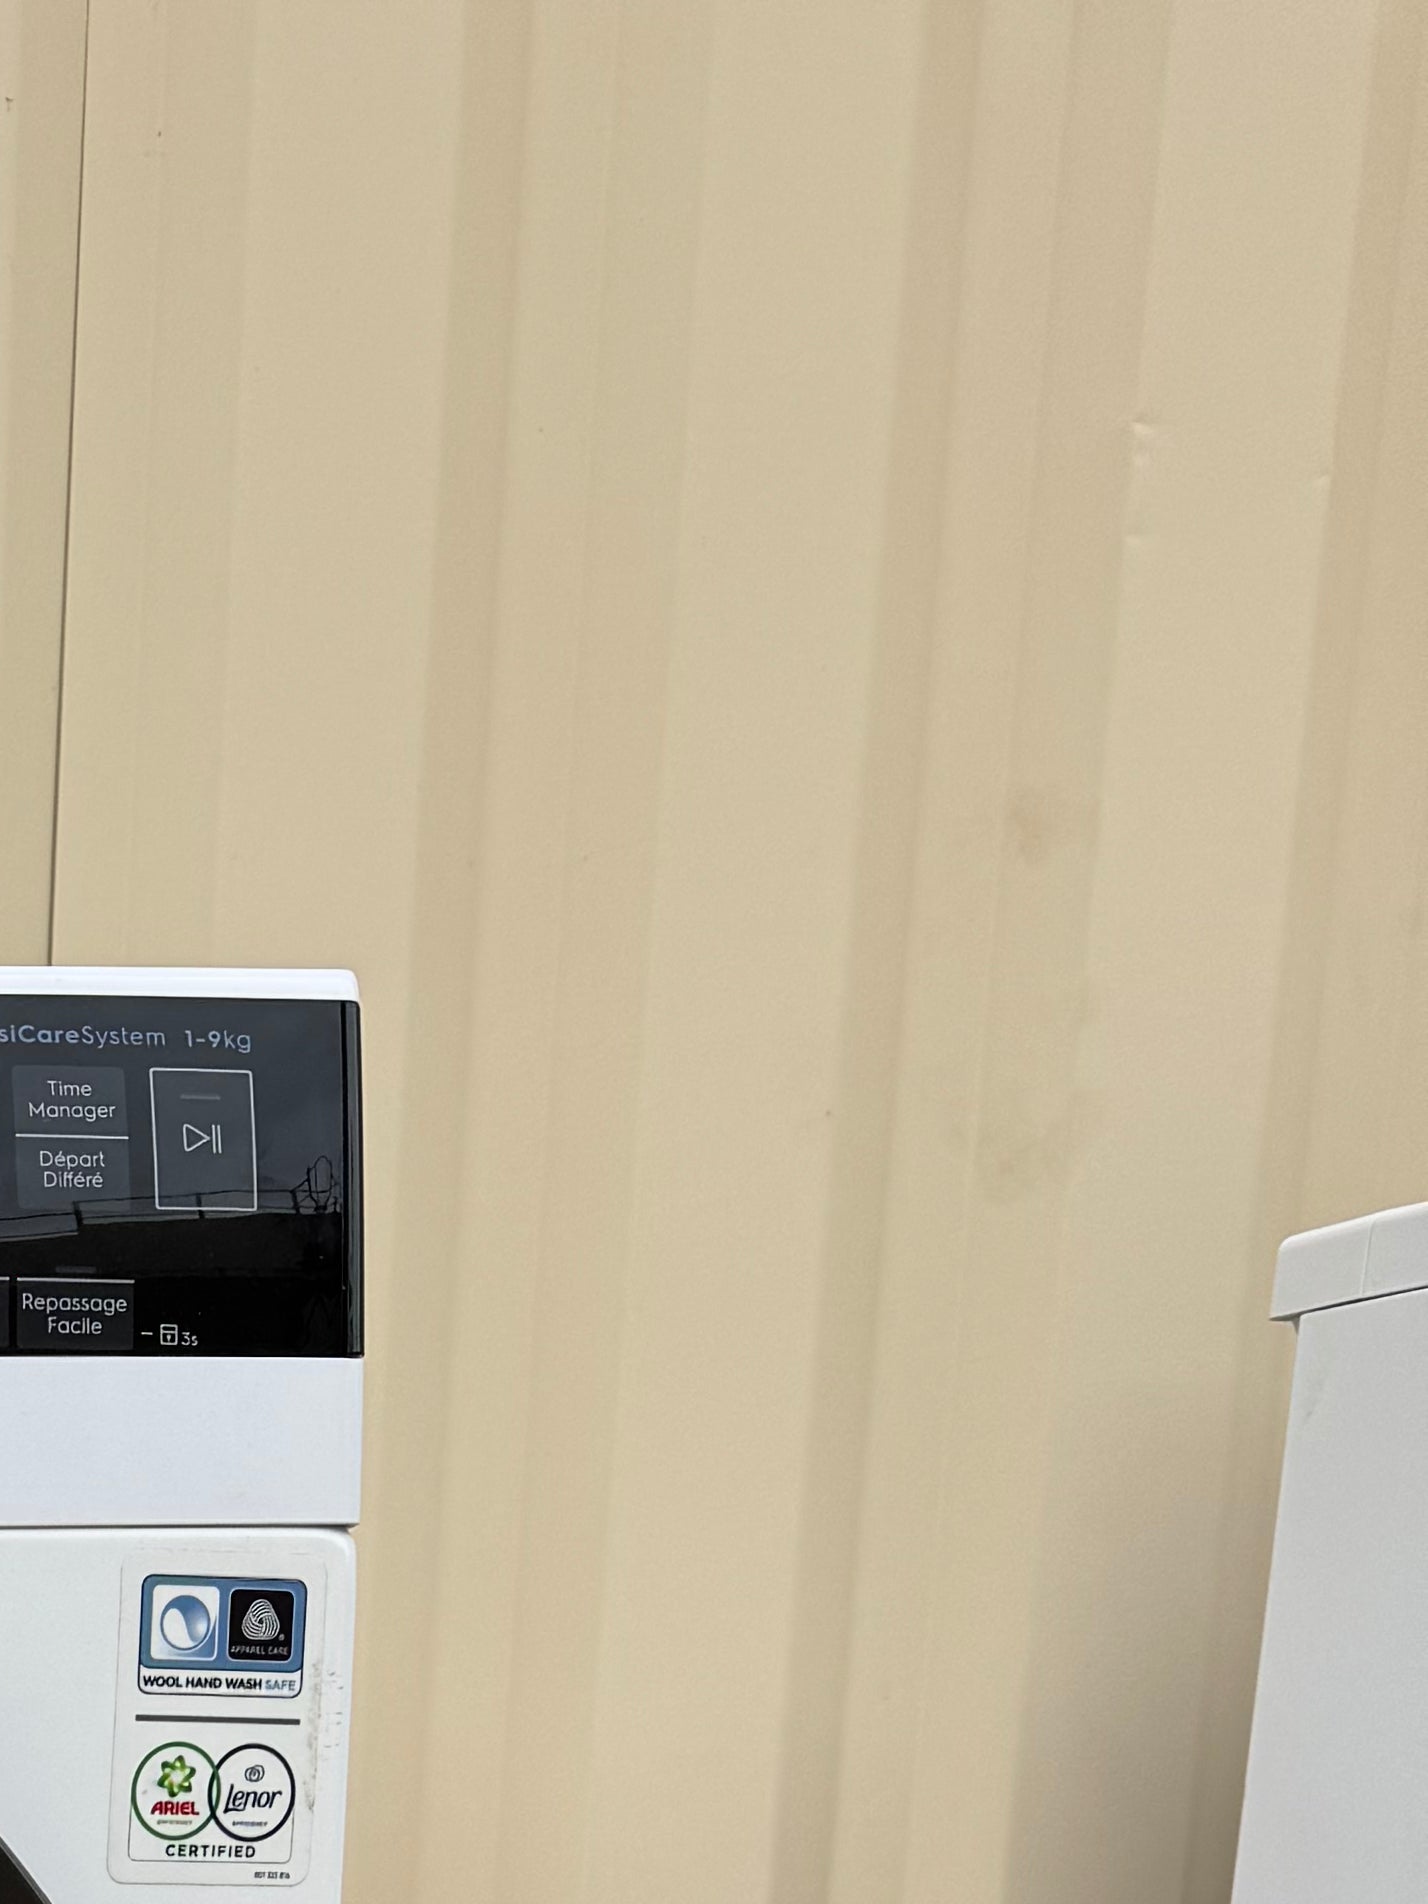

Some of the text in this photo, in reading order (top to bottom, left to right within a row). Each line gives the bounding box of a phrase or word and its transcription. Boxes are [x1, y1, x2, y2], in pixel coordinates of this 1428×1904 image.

[184, 1029, 251, 1054] 1-9kg
[46, 1080, 92, 1097] Time
[28, 1102, 116, 1123] Manager
[39, 1150, 105, 1171] Départ
[43, 1170, 104, 1188] Différé
[22, 1292, 128, 1316] Repassage
[47, 1316, 103, 1335] Facile
[181, 1331, 199, 1347] 3s
[142, 1675, 297, 1692] WOOL HAND WASH SAFE
[150, 1800, 200, 1816] ARIEL
[222, 1783, 283, 1815] Lenor
[165, 1843, 256, 1859] CERTIFIED
